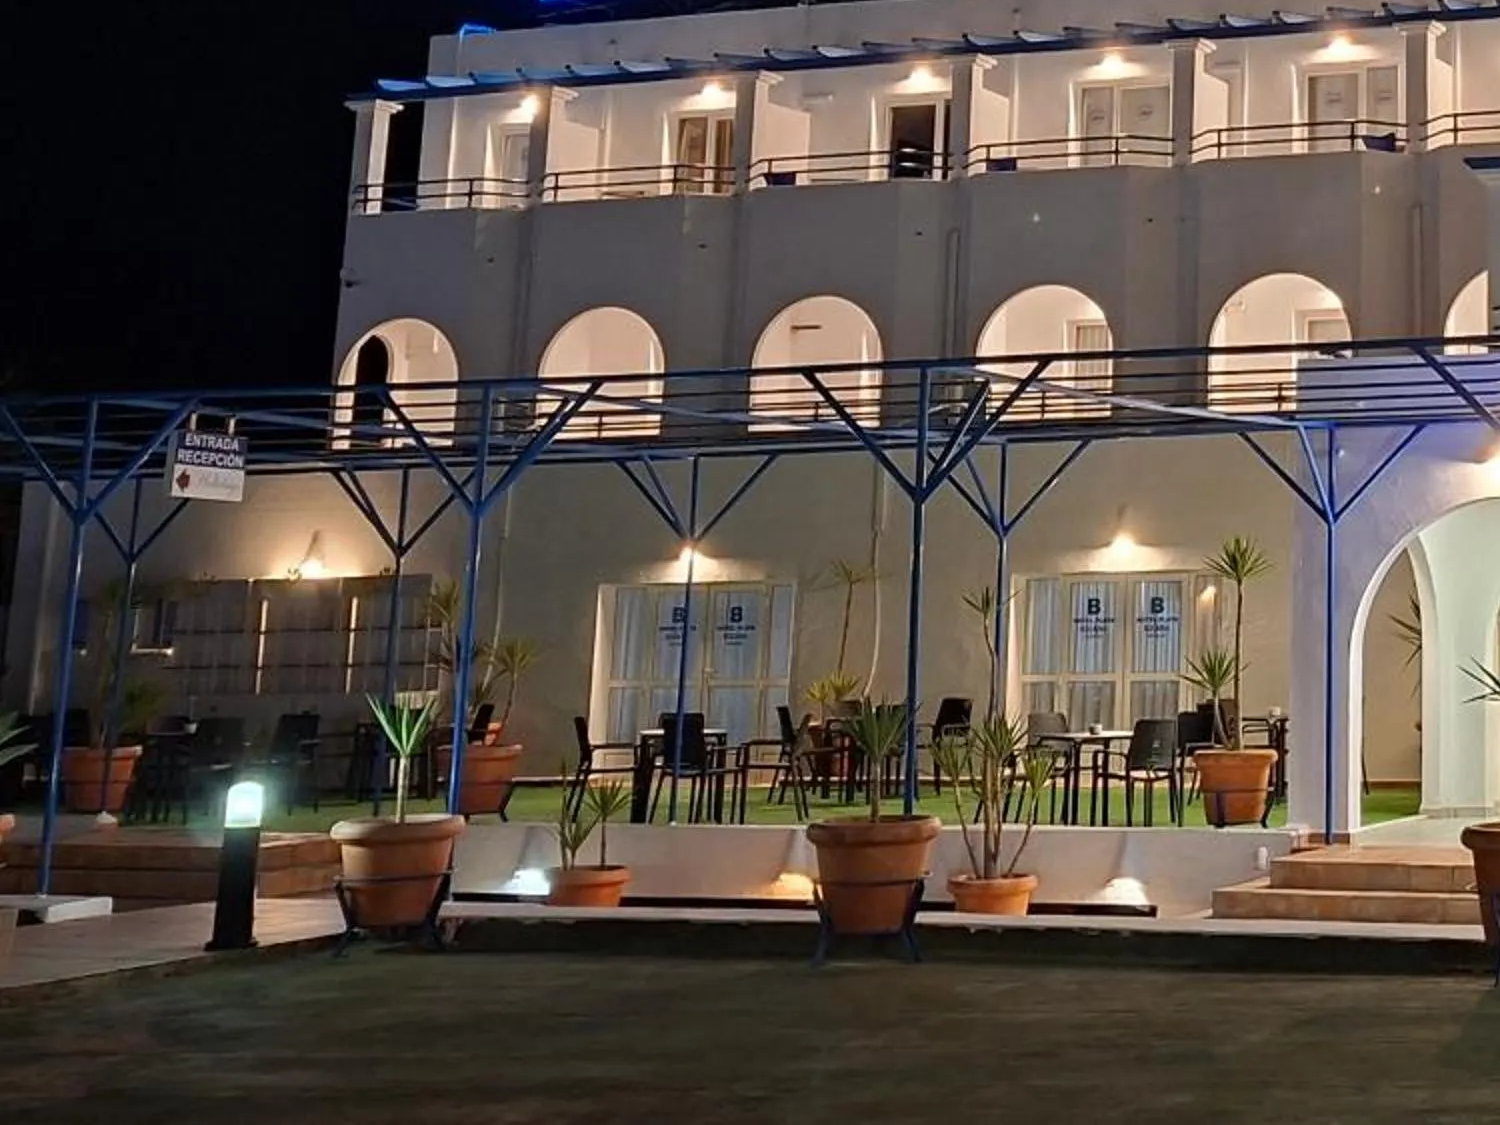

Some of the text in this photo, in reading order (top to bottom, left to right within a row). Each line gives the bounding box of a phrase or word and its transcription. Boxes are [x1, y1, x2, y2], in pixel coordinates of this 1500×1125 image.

[185, 433, 239, 451] ENTRADA
[1087, 598, 1101, 615] B
[1151, 596, 1165, 614] B
